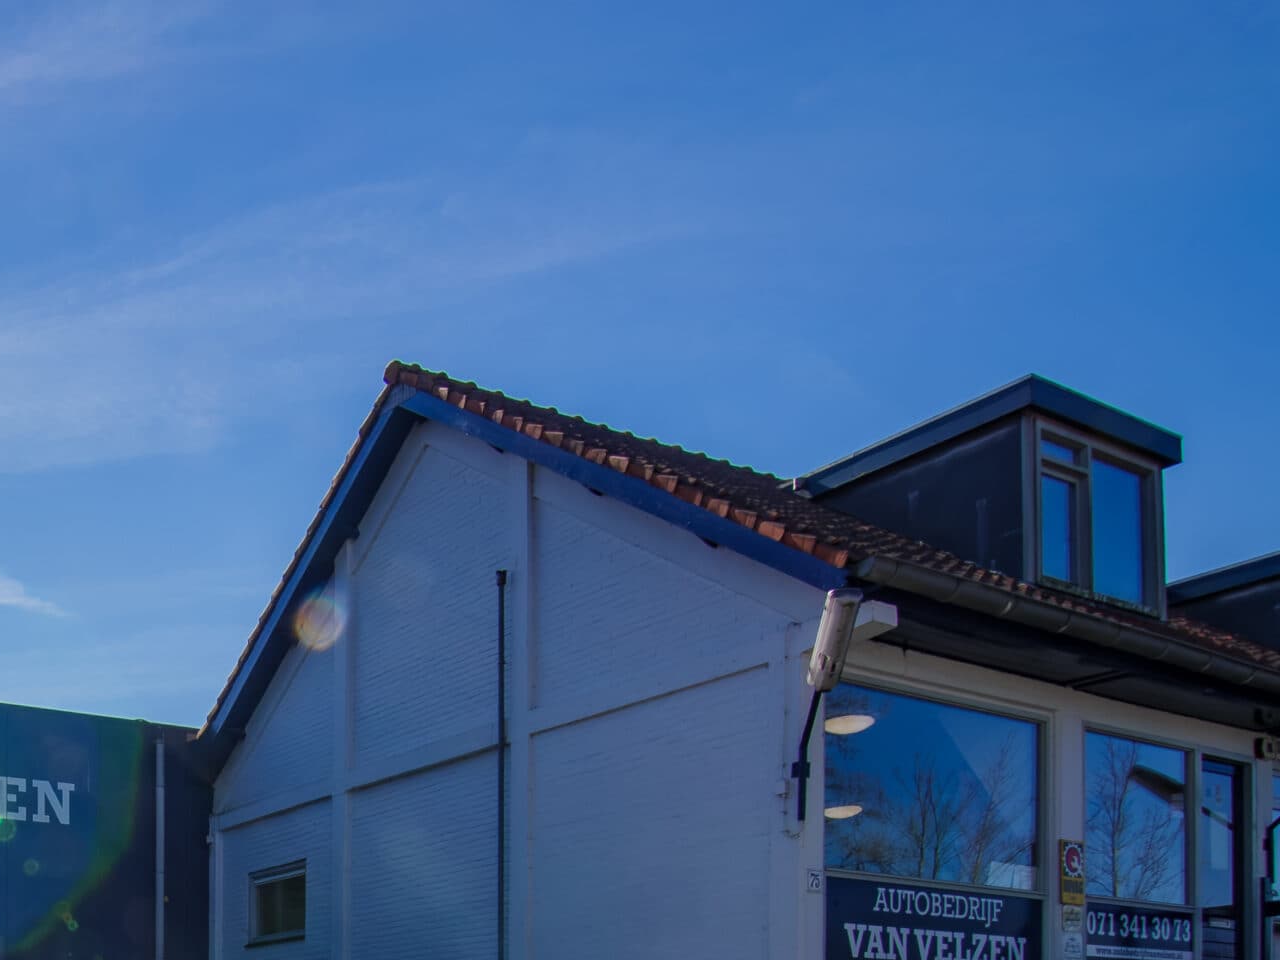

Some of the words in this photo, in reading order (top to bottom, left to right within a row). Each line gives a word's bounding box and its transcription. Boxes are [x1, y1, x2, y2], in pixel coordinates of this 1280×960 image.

[810, 873, 821, 889] 75
[873, 887, 1004, 928] AUTOBEDRIJF
[1086, 911, 1116, 936] 071
[1120, 914, 1148, 939] 341
[1151, 916, 1171, 941] 30
[1173, 919, 1192, 943] 73
